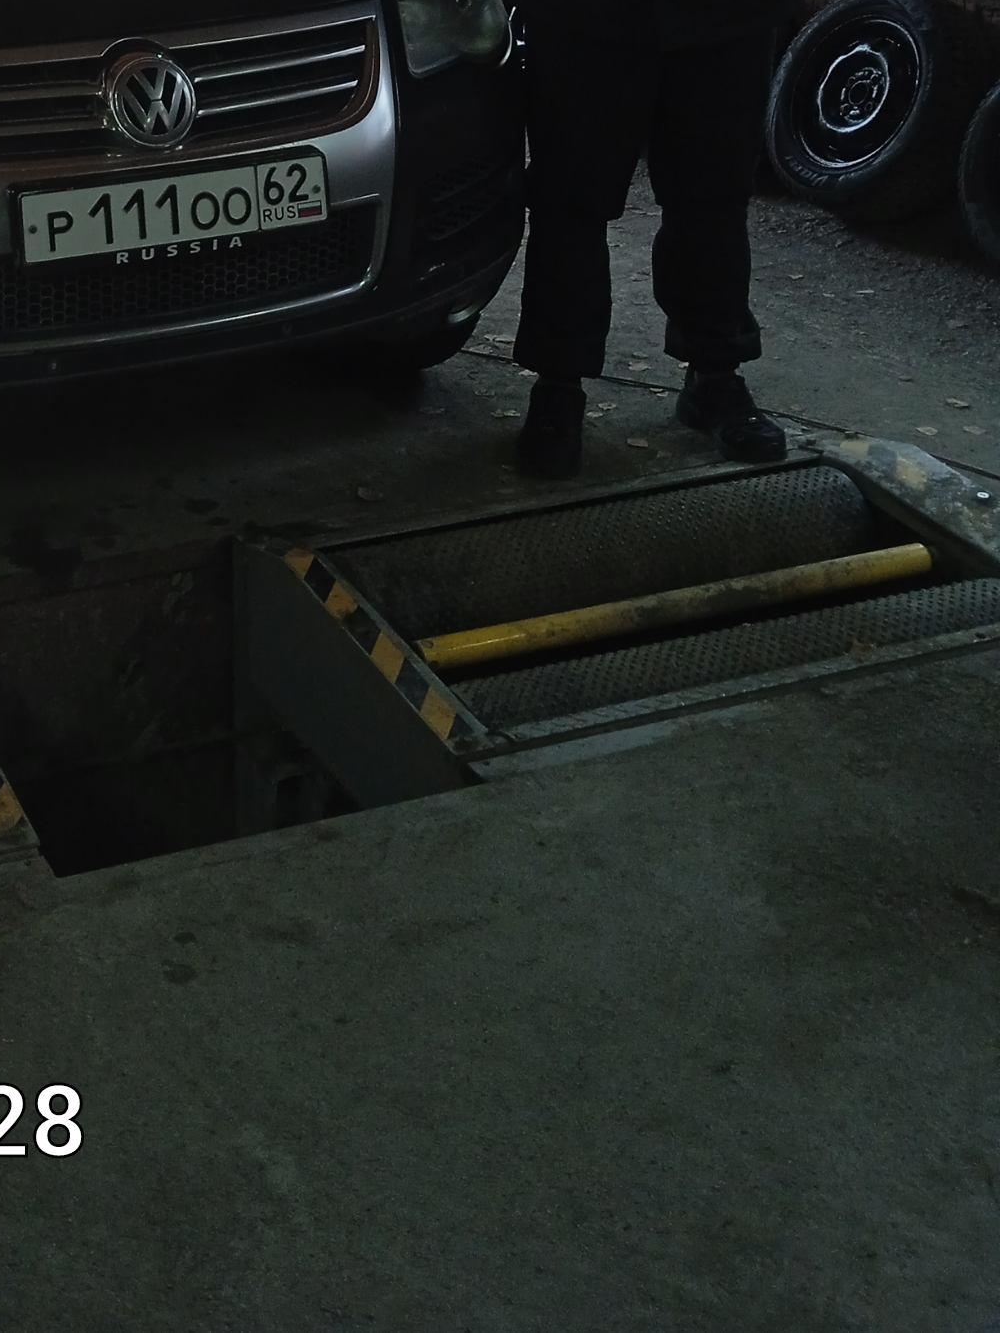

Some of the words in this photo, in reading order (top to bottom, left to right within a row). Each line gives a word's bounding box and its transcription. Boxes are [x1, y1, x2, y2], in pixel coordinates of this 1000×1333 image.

[263, 163, 310, 206] 62
[262, 206, 297, 223] RUS
[115, 236, 243, 264] RUSSIA
